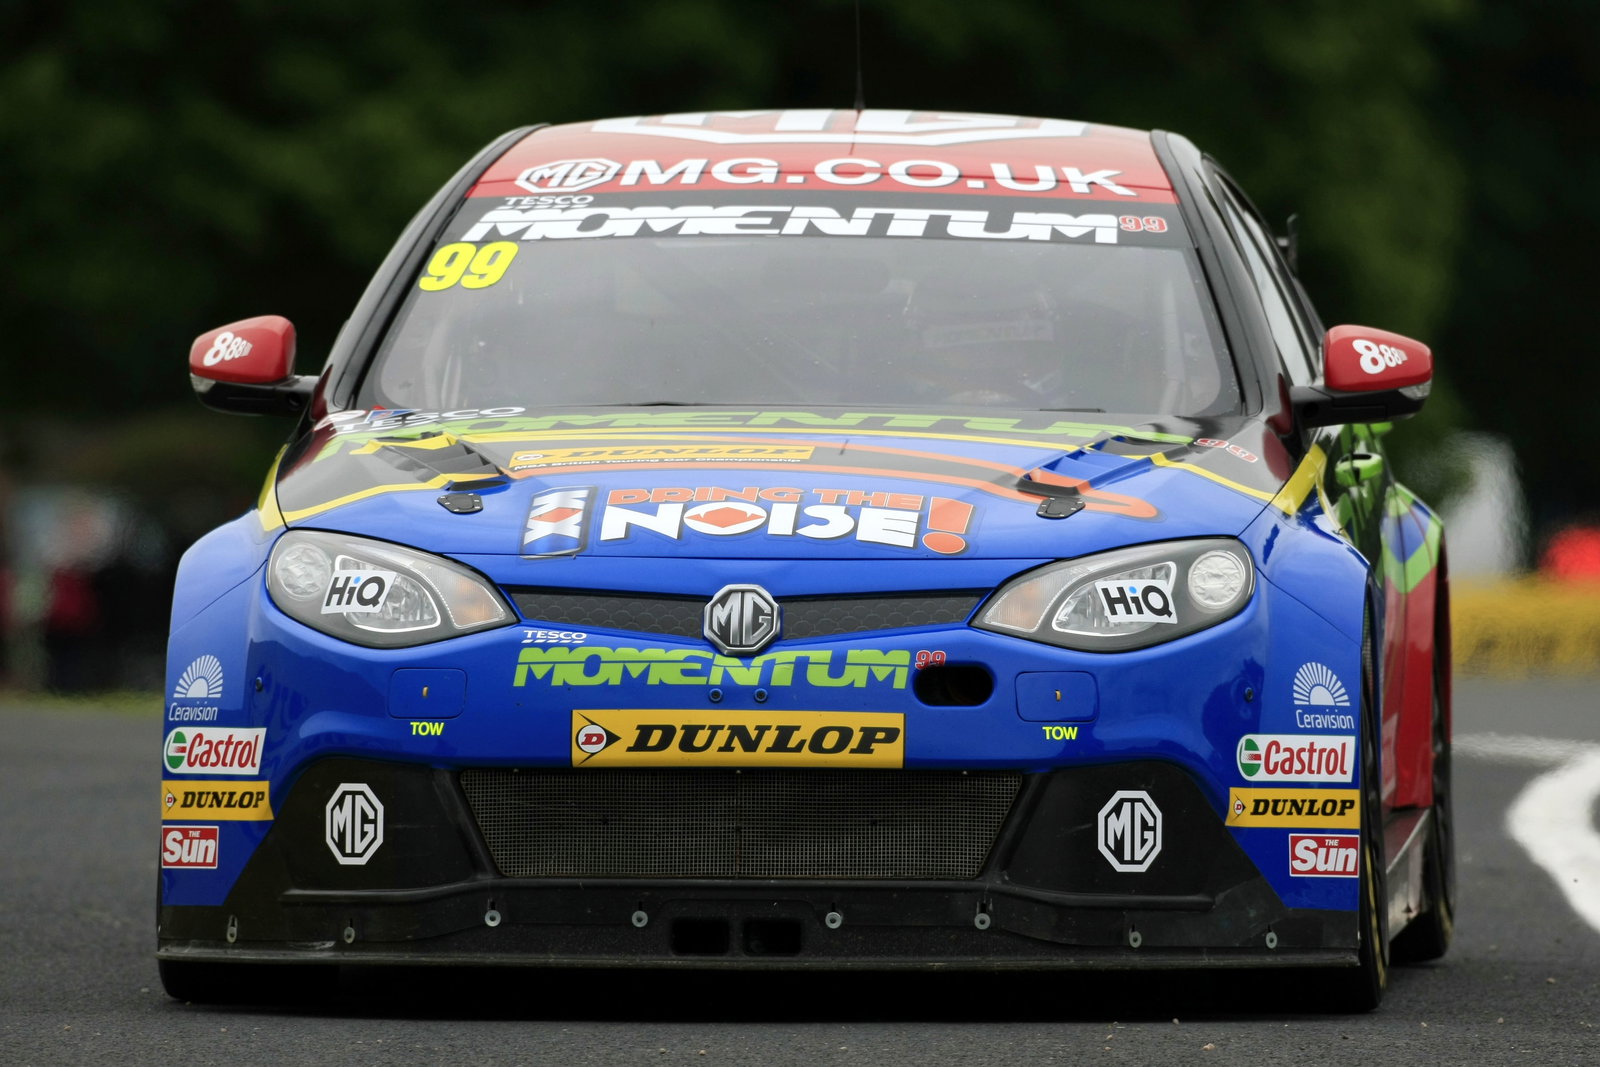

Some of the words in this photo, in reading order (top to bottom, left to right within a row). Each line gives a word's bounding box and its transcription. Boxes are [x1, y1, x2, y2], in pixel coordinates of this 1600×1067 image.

[619, 157, 1138, 197] MG.CO.UK
[504, 194, 595, 206] TESCO
[460, 206, 1118, 244] MOMENTUM
[1118, 214, 1169, 233] 99
[418, 240, 519, 291] 99
[330, 406, 526, 432] TESCO
[561, 447, 810, 459] DUNLOP
[812, 488, 925, 511] THE
[325, 575, 386, 608] HiQ
[1101, 584, 1173, 619] HiQ
[711, 590, 773, 647] MG
[523, 629, 588, 641] TESCO
[513, 646, 911, 690] MOMENTUM
[915, 649, 947, 671] 99
[168, 700, 219, 721] Ceravision
[1295, 708, 1355, 730] Ceravision
[410, 721, 445, 736] TOW
[625, 723, 901, 755] DUNLOP
[1042, 726, 1079, 740] TOW
[186, 731, 261, 769] Castrol
[1264, 739, 1348, 776] Castrol
[180, 791, 265, 809] DUNLOP
[1250, 798, 1355, 816] DUNLOP
[162, 830, 216, 864] Sun
[1291, 837, 1358, 872] Sun
[1324, 838, 1340, 846] THE
